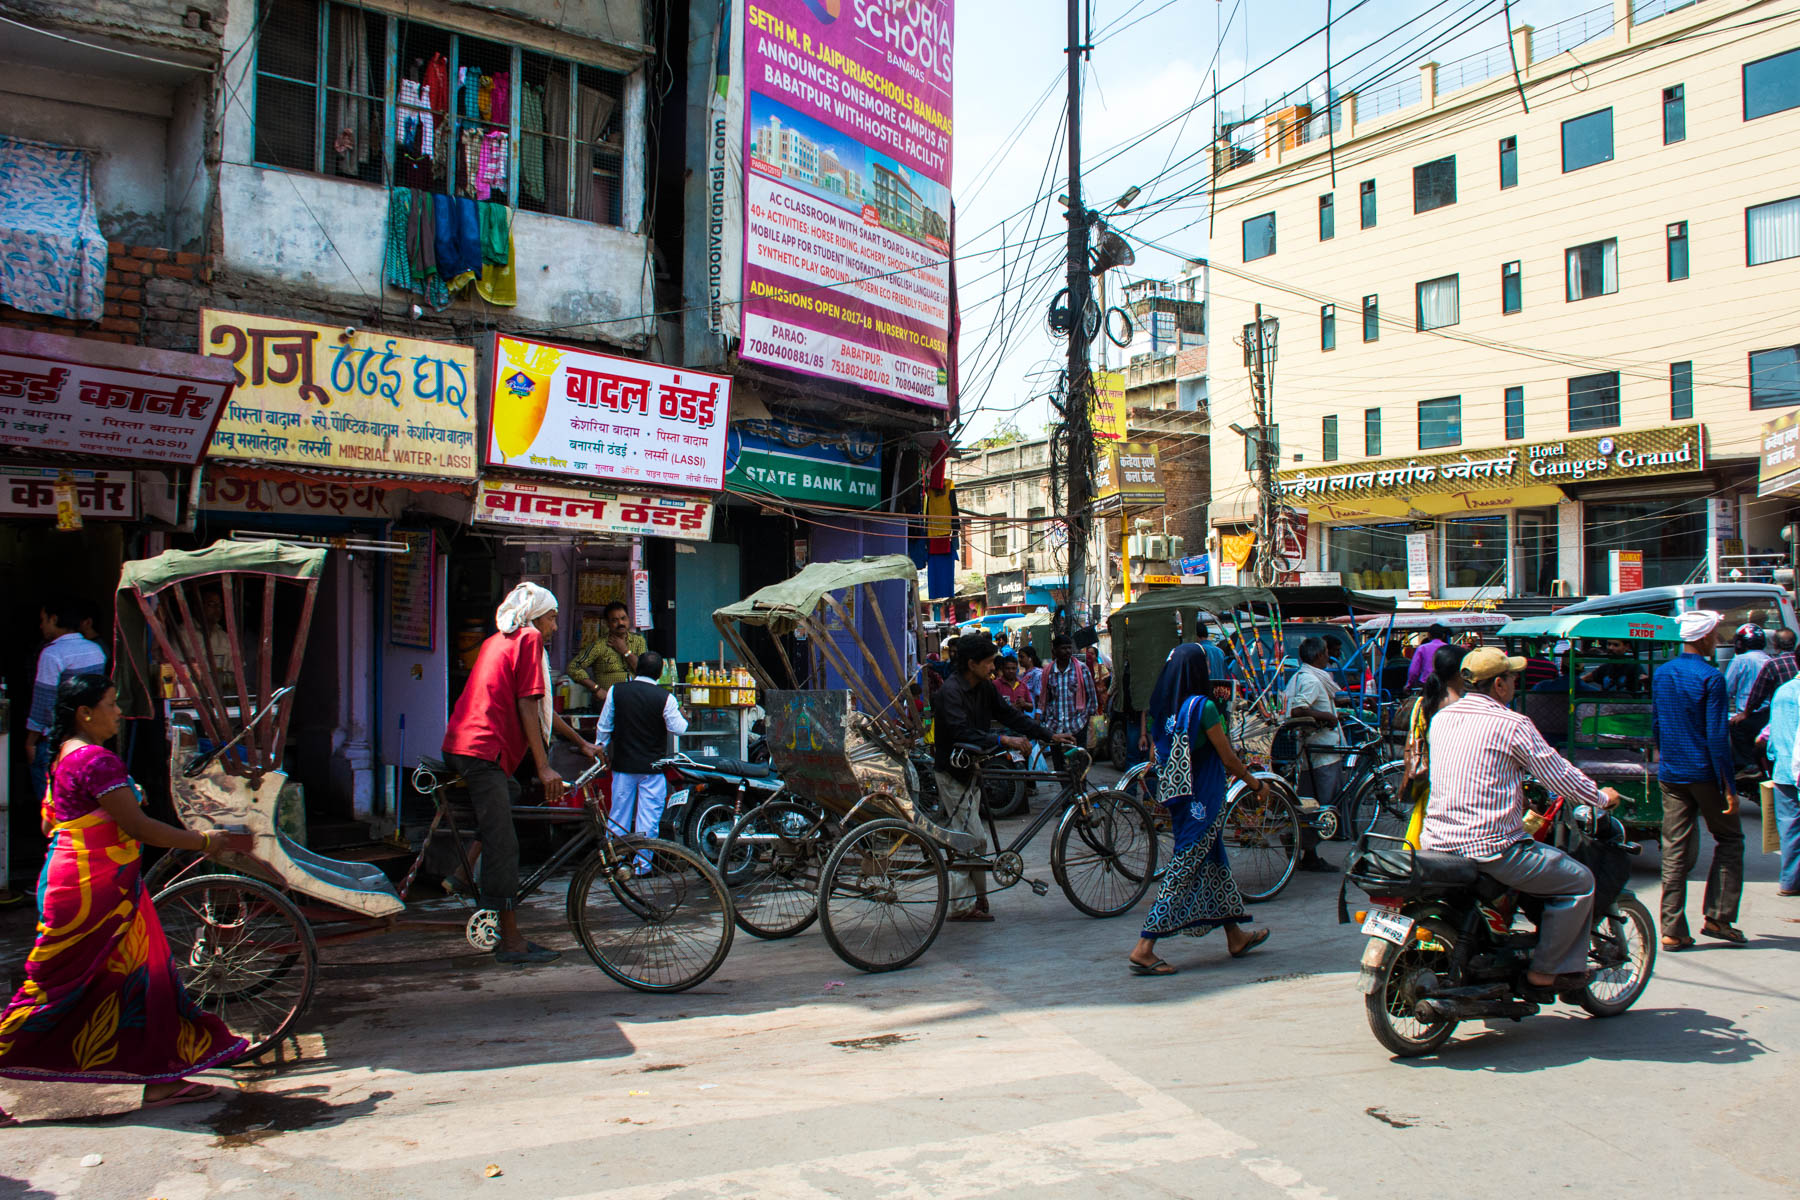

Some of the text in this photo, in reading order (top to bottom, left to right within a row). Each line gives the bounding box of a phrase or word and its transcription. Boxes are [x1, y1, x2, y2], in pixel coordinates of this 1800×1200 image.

[854, 0, 951, 82] SCHOOLS
[749, 5, 784, 40] SETH
[786, 24, 801, 48] M.
[803, 33, 815, 57] R.
[914, 97, 953, 136] BANARAS
[886, 50, 925, 83] BANARAS
[758, 37, 839, 93] ANNOUNCES
[898, 112, 936, 146] CAMPUS
[937, 137, 948, 153] AT
[764, 64, 831, 112] BABATPUR
[905, 138, 944, 172] FACILITY
[750, 203, 766, 218] 40+
[767, 209, 810, 234] ACTIVITIES:
[811, 226, 835, 245] HORSE
[769, 191, 782, 206] AC
[784, 196, 837, 227] CLASSROOM
[838, 216, 858, 235] WITH
[882, 237, 904, 256] BOARD
[905, 248, 910, 259] &
[911, 252, 920, 264] AC
[920, 255, 939, 271] BUSES
[750, 222, 780, 243] MOBILE
[782, 232, 796, 248] APP
[798, 239, 811, 254] FOR
[813, 245, 844, 265] STUDENT
[845, 255, 885, 281] INFORMATION
[890, 275, 912, 291] ENGLISH
[913, 283, 940, 303] LANGUAGE
[757, 243, 945, 320] SYNTHETIC PLAY GROUND MODERN ECO FRIENDLY FURNITURE
[750, 280, 813, 311] ADMISSIONS
[815, 299, 841, 320] OPEN
[842, 308, 872, 330] 2017-18
[875, 319, 908, 341] NURSERY
[909, 330, 919, 345] TO
[920, 335, 941, 351] CLASS
[772, 325, 808, 346] PARAO:
[209, 324, 331, 406] राजू
[410, 354, 468, 418] घर
[840, 343, 884, 368] BABATPUR:
[894, 360, 911, 375] CITY
[565, 366, 721, 430] बादल ठंडई
[127, 435, 188, 450] (LASSI)
[228, 401, 263, 425] पिस्ता
[265, 410, 301, 430] बादाम
[370, 422, 400, 439] बादाम
[446, 430, 473, 449] बादाम
[570, 416, 709, 448] केशरिया बादाम पिस्ता बादाम
[298, 436, 333, 459] लस्सी
[339, 444, 471, 469] MINERIAL WATER LASSI
[569, 439, 604, 454] बनारसी
[644, 449, 669, 462] लस्सी
[671, 454, 707, 468] (LASSI)
[1528, 442, 1565, 459] Hotel
[1528, 442, 1692, 479] Ganges Grand
[745, 466, 877, 497] STATE BANK ATM
[1328, 471, 1376, 492] लाल
[1441, 451, 1518, 479] ज्वेलर्स
[483, 489, 707, 530] बादल ठंडई
[1629, 629, 1655, 639] EXIDE
